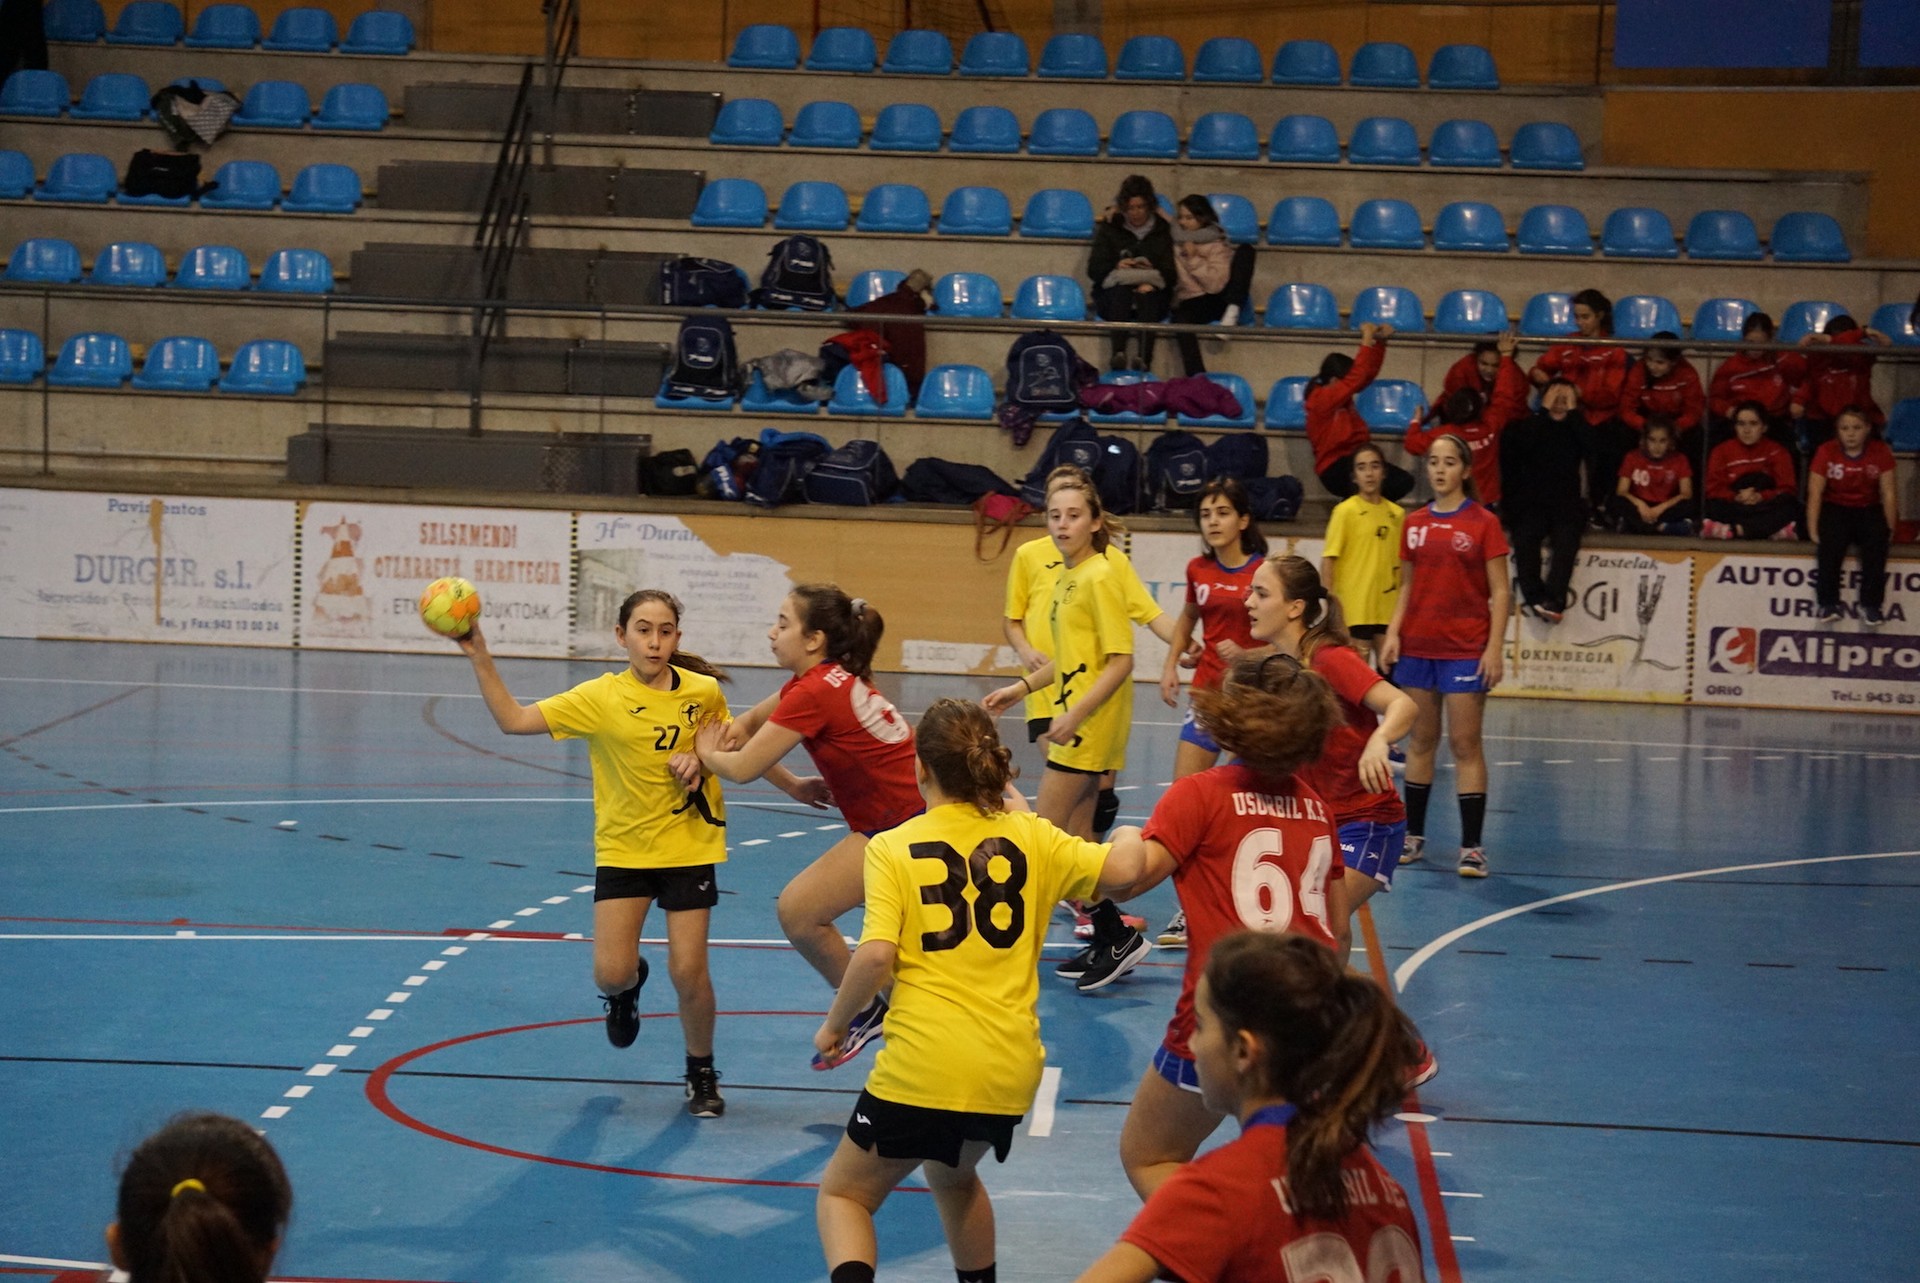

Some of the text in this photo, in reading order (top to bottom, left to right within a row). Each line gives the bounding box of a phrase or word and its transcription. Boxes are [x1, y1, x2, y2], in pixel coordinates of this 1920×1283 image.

[108, 498, 207, 516] Pavientos
[1407, 525, 1428, 550] 61
[1706, 684, 1743, 697] ORIO
[1866, 692, 1892, 704] 943
[653, 725, 681, 751] 27
[1231, 791, 1302, 819] USURBIL
[908, 836, 1028, 952] 38
[1231, 827, 1334, 938] 64
